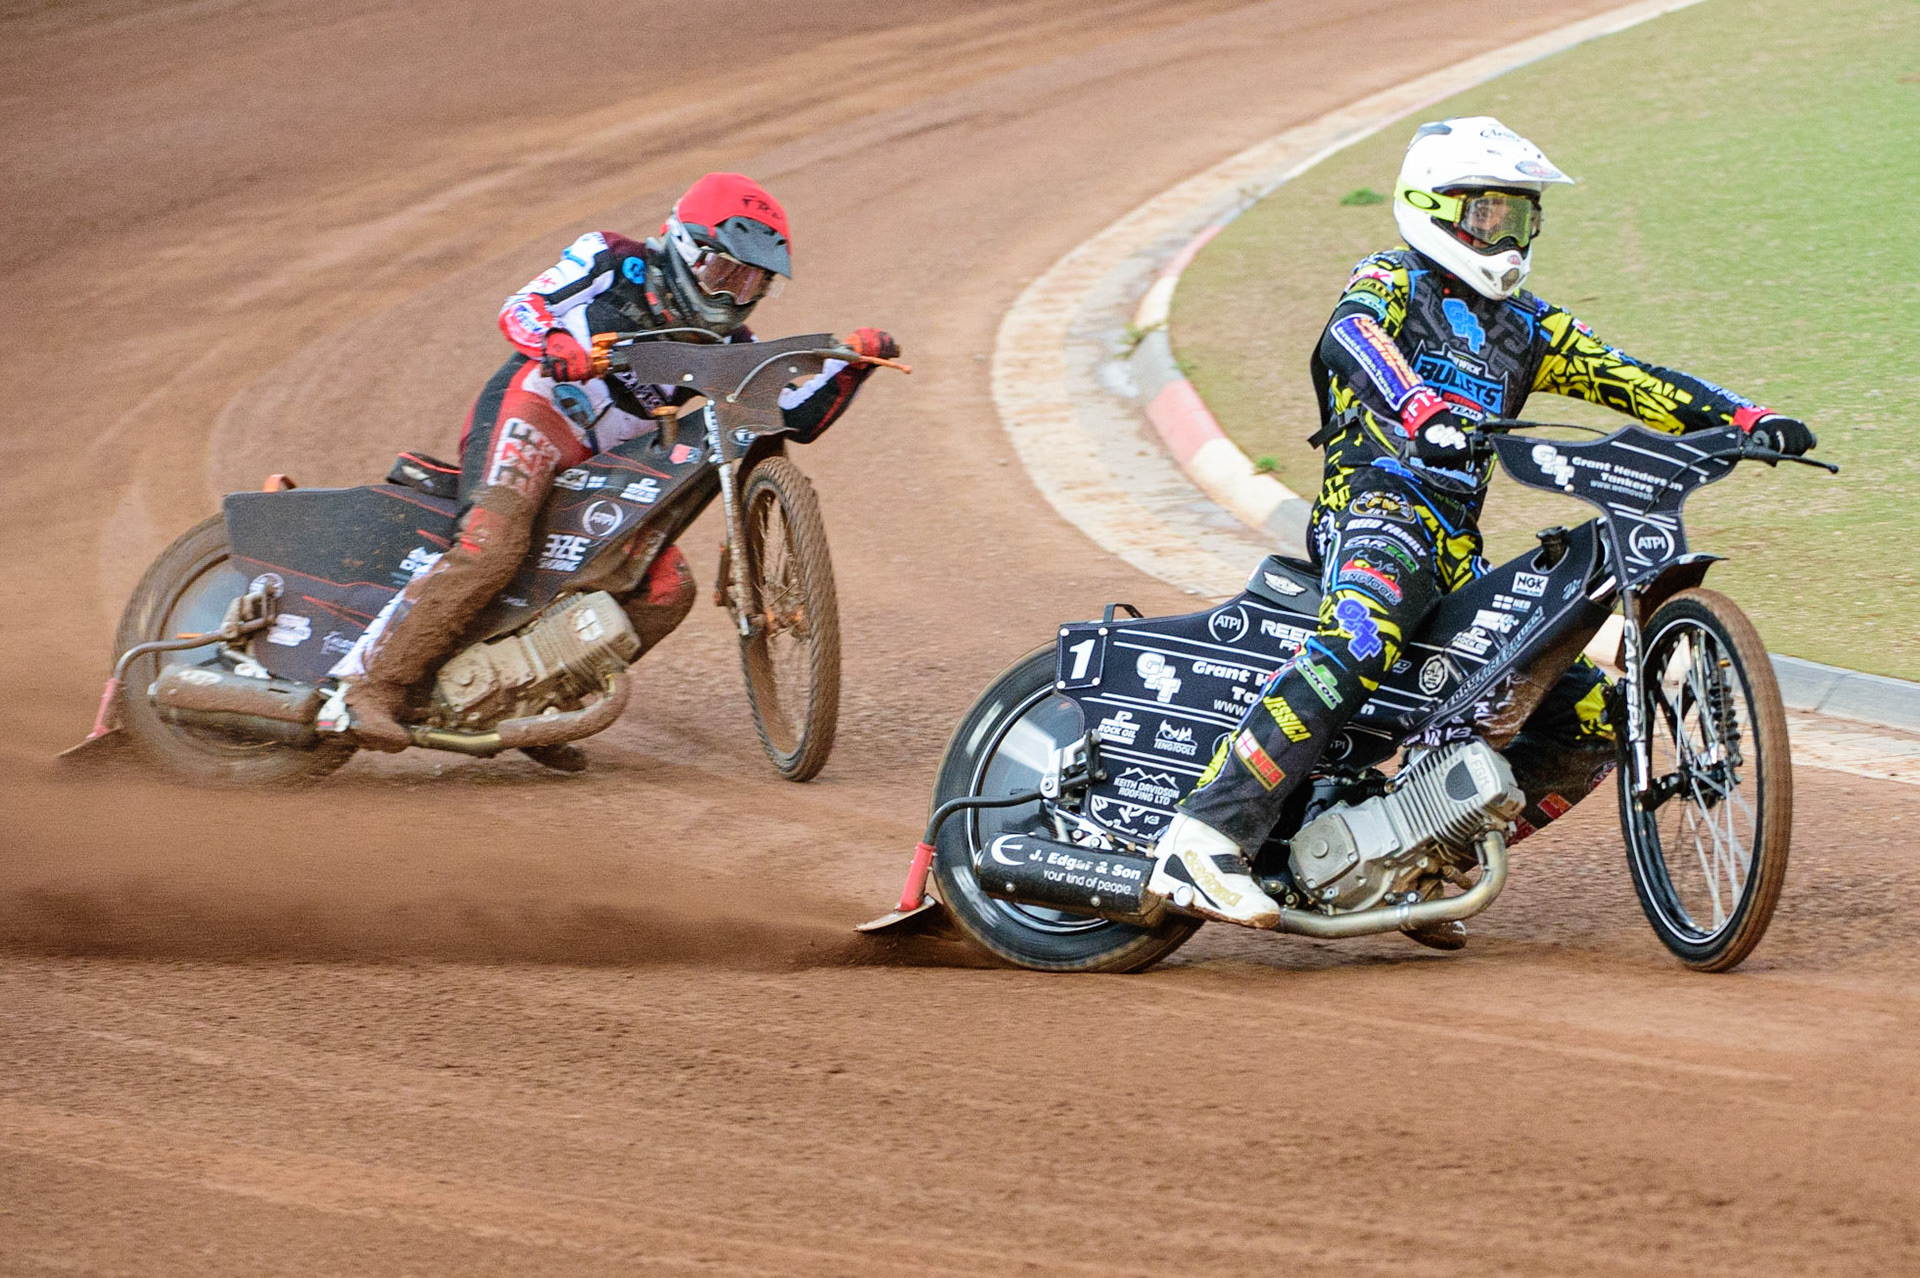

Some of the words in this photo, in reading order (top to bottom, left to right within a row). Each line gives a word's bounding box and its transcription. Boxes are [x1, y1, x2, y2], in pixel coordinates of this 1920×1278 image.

[1417, 359, 1503, 407] BULLETS
[1571, 455, 1612, 472] Grant
[1600, 472, 1654, 494] Tankers
[1637, 536, 1666, 550] ATPI
[1517, 575, 1545, 590] NGK
[1215, 614, 1242, 631] ATPI
[1069, 639, 1095, 679] 1
[1192, 660, 1250, 684] Grant
[1262, 695, 1312, 743] JESSICA
[1097, 723, 1119, 737] ROCK
[1119, 727, 1137, 739] OIL
[1154, 738, 1197, 756] TENGTOOLS
[1113, 777, 1138, 790] KEITH
[1138, 781, 1180, 799] DAVIDSON
[1118, 786, 1153, 803] ROOFING
[1153, 793, 1171, 806] LTD
[1029, 849, 1043, 863] J.
[1047, 852, 1094, 872] Edgar
[1094, 861, 1109, 874] &
[1111, 863, 1142, 881] Son
[1043, 869, 1066, 882] Your
[1065, 872, 1085, 887] kind
[1084, 874, 1098, 888] of
